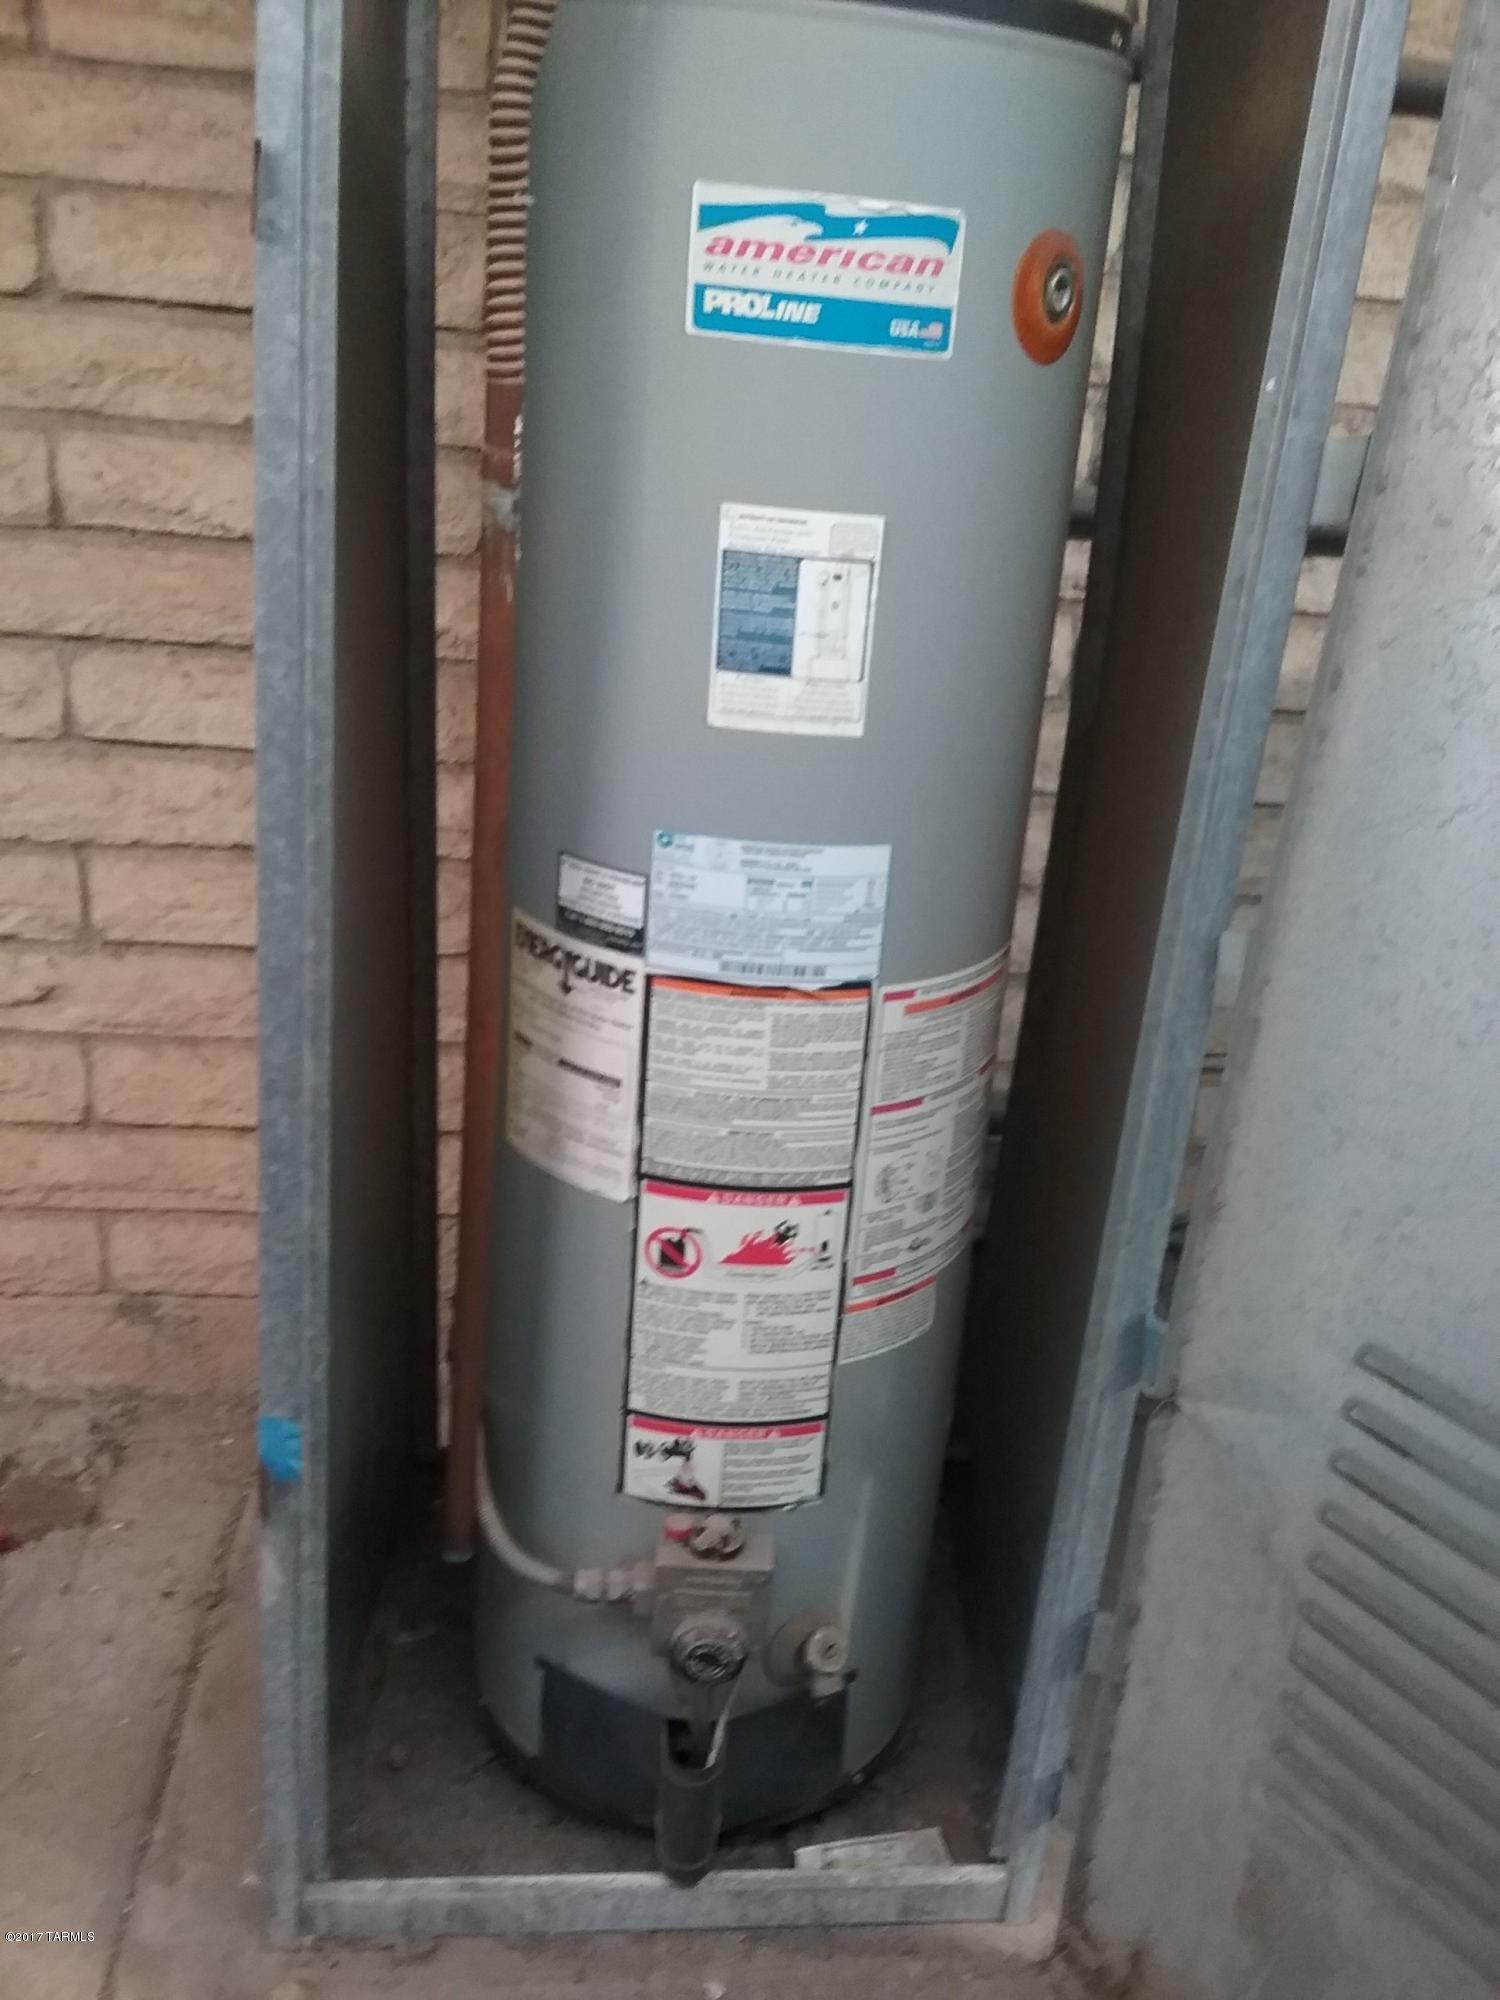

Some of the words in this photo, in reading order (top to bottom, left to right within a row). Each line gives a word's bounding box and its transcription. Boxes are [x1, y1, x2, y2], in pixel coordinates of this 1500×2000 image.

[705, 236, 944, 276] american
[703, 262, 761, 278] WATER
[773, 269, 841, 285] HEATER
[853, 276, 937, 294] COMPANY
[889, 318, 919, 339] USA
